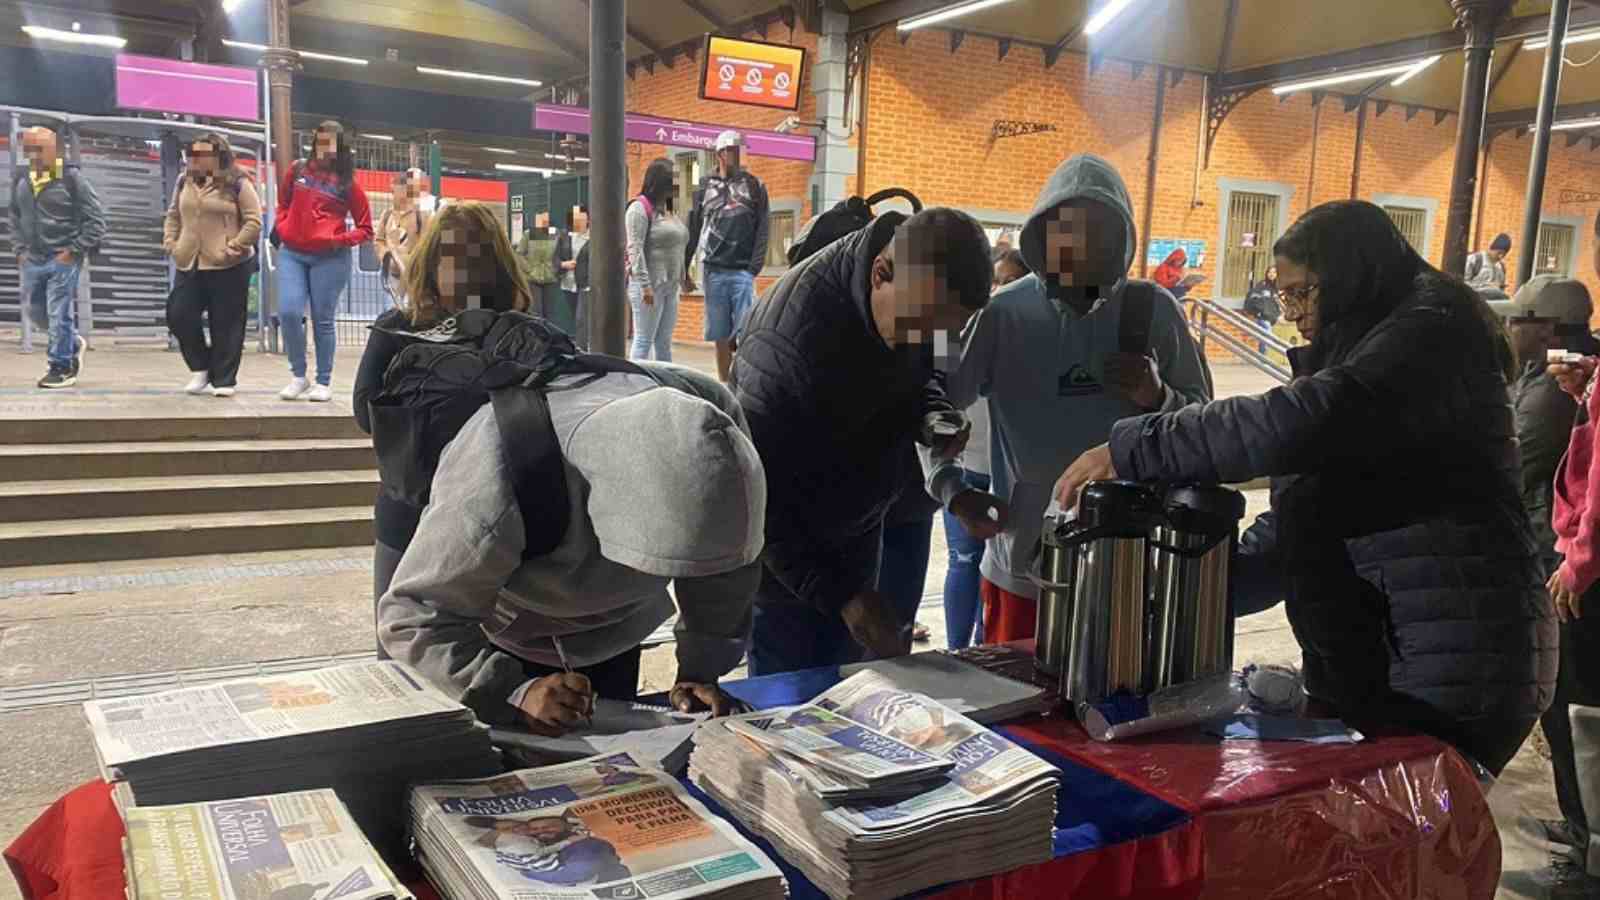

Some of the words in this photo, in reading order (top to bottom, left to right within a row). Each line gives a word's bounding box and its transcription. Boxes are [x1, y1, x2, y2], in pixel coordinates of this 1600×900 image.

[443, 797, 561, 815] UNIVERSAL
[600, 790, 665, 808] MOMENTO
[605, 798, 674, 817] DECISIVO
[616, 810, 656, 825] PARA
[648, 813, 690, 829] FILHA
[214, 802, 249, 865] UNIVERSAL
[241, 808, 271, 847] FOLHA
